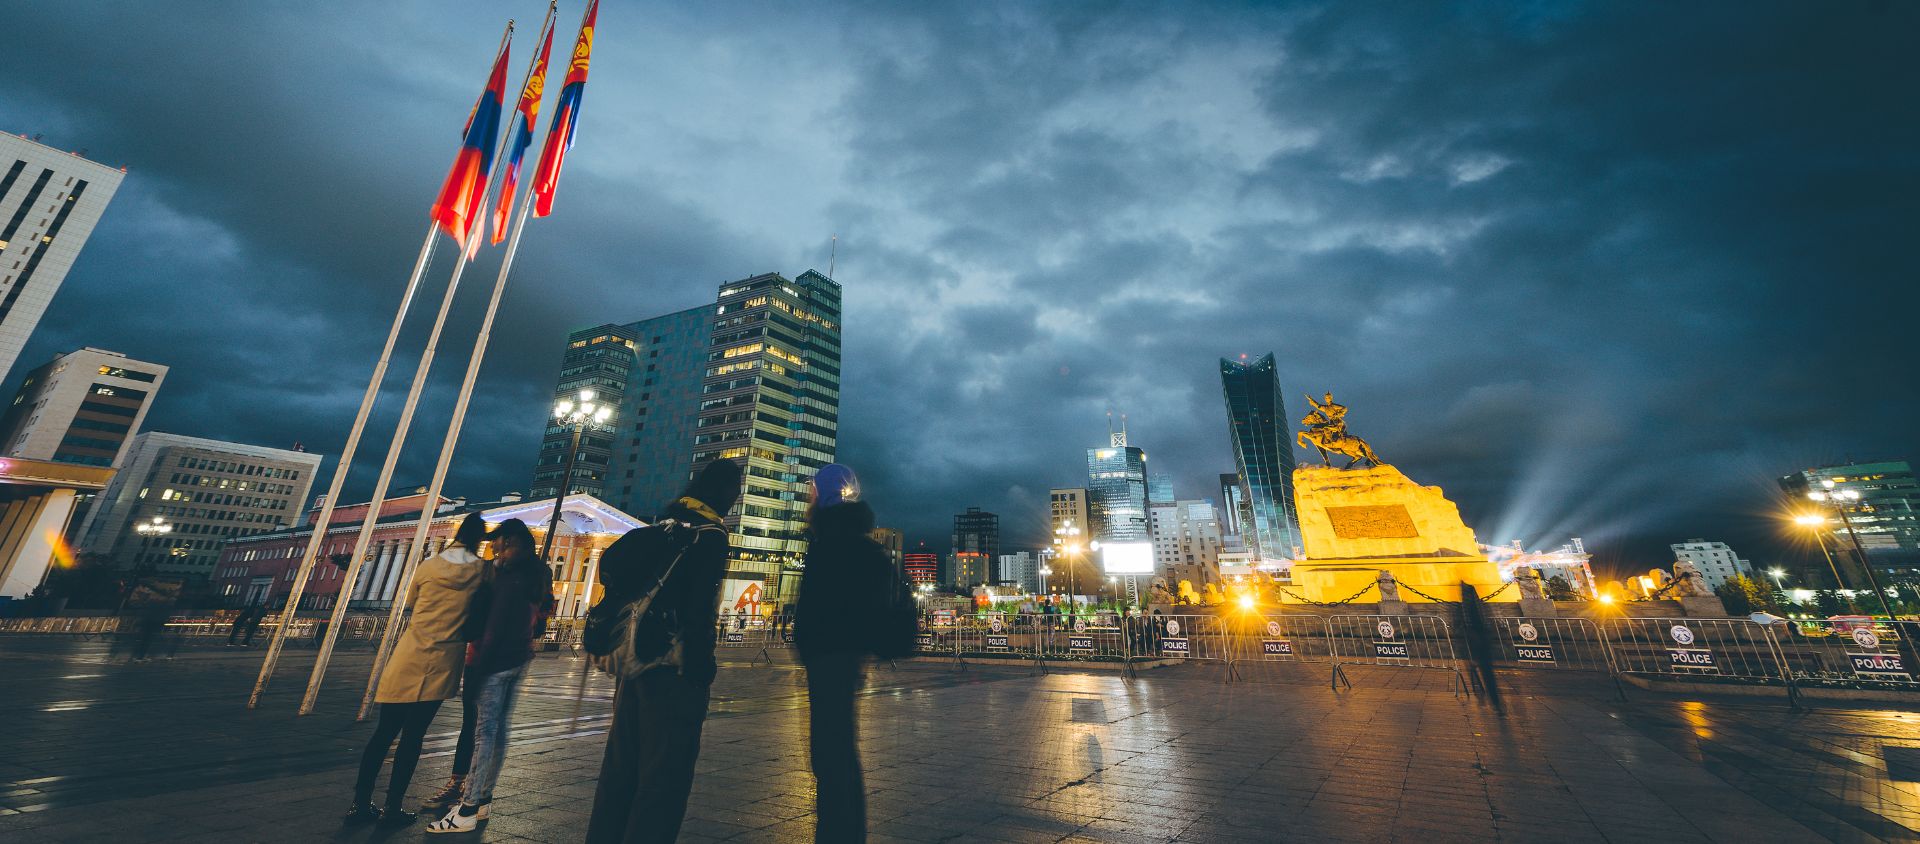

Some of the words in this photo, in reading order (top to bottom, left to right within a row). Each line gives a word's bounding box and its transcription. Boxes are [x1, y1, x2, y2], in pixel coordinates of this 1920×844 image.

[1071, 640, 1092, 648] POLICE
[1164, 642, 1187, 650] POLICE
[1265, 644, 1290, 652] POLICE
[1376, 646, 1406, 655] POLICE
[1518, 649, 1552, 658] POLICE
[1672, 653, 1712, 664] POLICE
[1854, 658, 1903, 670] POLICE
